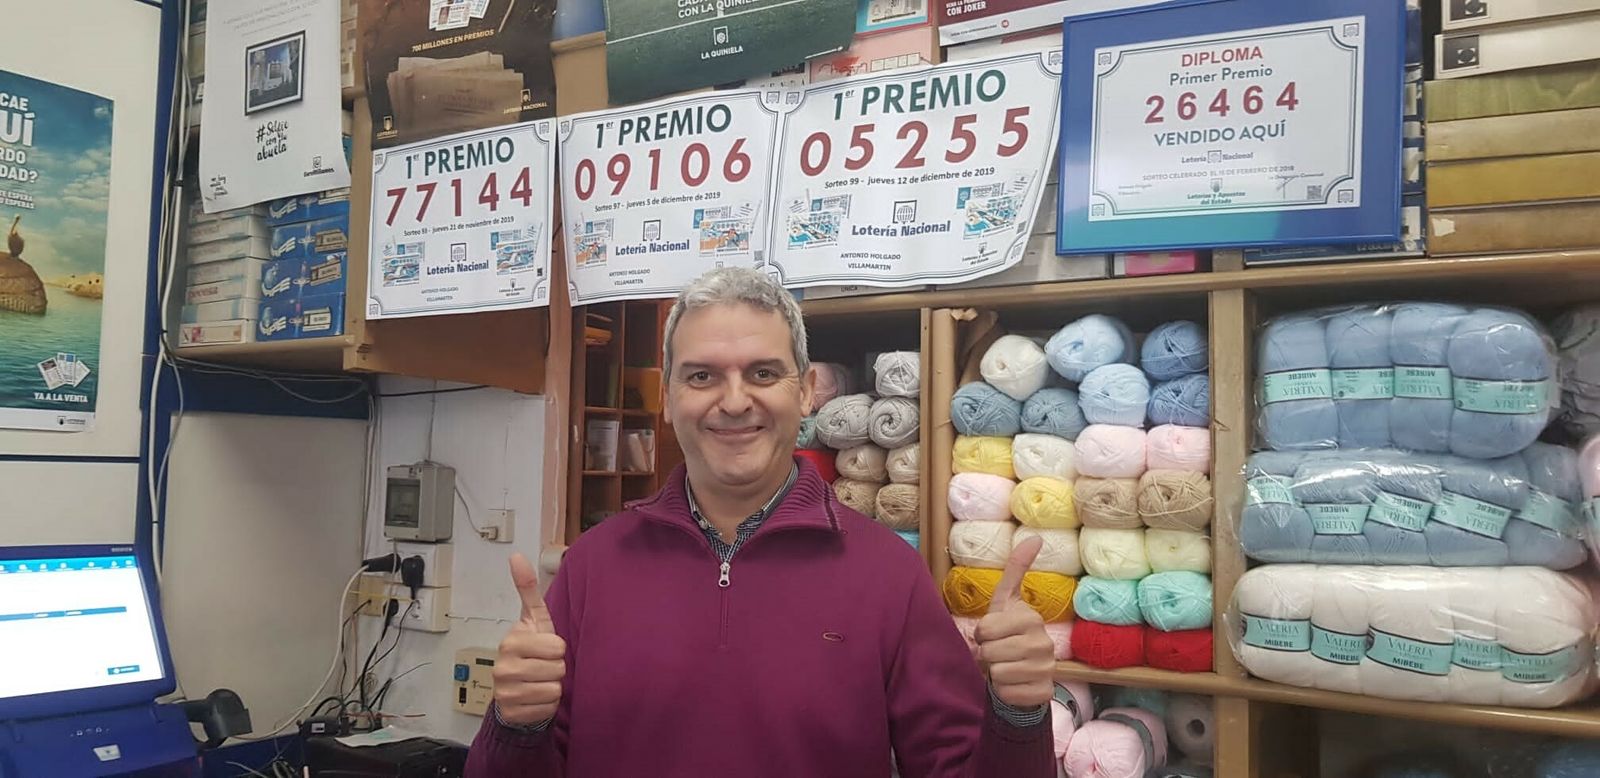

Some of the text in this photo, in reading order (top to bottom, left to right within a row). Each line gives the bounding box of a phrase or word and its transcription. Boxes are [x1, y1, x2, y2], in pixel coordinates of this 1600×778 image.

[678, 6, 699, 18] CON
[701, 3, 714, 13] LA
[946, 6, 962, 17] CON
[963, 1, 987, 13] JOKER
[422, 37, 453, 50] MILLONES
[454, 35, 464, 43] EN
[463, 29, 495, 41] PREMIOS
[701, 45, 744, 60] LA QUINIELA
[1181, 46, 1263, 68] DIPLOMA
[1169, 64, 1273, 86] Primer Premio
[860, 69, 1007, 116] PREMIO
[0, 92, 29, 111] CAE
[1144, 81, 1299, 124] 26464
[618, 103, 732, 146] PREMIO
[1154, 119, 1286, 147] VENDIDO AQUÍ
[265, 137, 277, 147] con
[800, 106, 1030, 177] 05255
[256, 141, 287, 161] abuela
[424, 136, 515, 176] PREMIO
[1222, 152, 1254, 161] Nacional
[574, 138, 752, 201] 09106
[824, 178, 848, 189] Sorteo
[849, 177, 859, 186] 99
[867, 176, 895, 186] jueves
[897, 176, 907, 185] 12
[909, 175, 919, 184] de
[920, 170, 960, 182] diciembre
[962, 168, 973, 178] de
[974, 166, 995, 177] 2019
[386, 166, 533, 226] 77144
[594, 204, 612, 213] Sorteo
[613, 202, 621, 210] 97
[626, 200, 646, 209] jueves
[660, 195, 694, 204] diciembre
[694, 193, 703, 201] de
[704, 191, 721, 200] 2019
[403, 229, 421, 237] Sorteo
[431, 226, 449, 234] jueves
[465, 219, 491, 229] noviembre
[492, 217, 500, 225] de
[500, 215, 515, 224] 2019
[851, 220, 951, 237] Lotería Nacional
[649, 239, 690, 253] Nacional
[456, 259, 489, 273] Nacional
[848, 263, 891, 271] VILLAMARTIN
[1288, 371, 1317, 381] MIBEBE
[34, 392, 88, 403] YA A LA VENTA
[1282, 384, 1326, 397] VALERIA
[1320, 505, 1350, 513] MIBEBE
[1257, 619, 1300, 634] VALERIA
[1264, 638, 1294, 648] MIBEBE
[1388, 637, 1434, 657] VALERIA
[1329, 652, 1360, 662] MIBEBE
[1392, 656, 1424, 670] MIBEBE
[1513, 672, 1547, 680] MIBEBE
